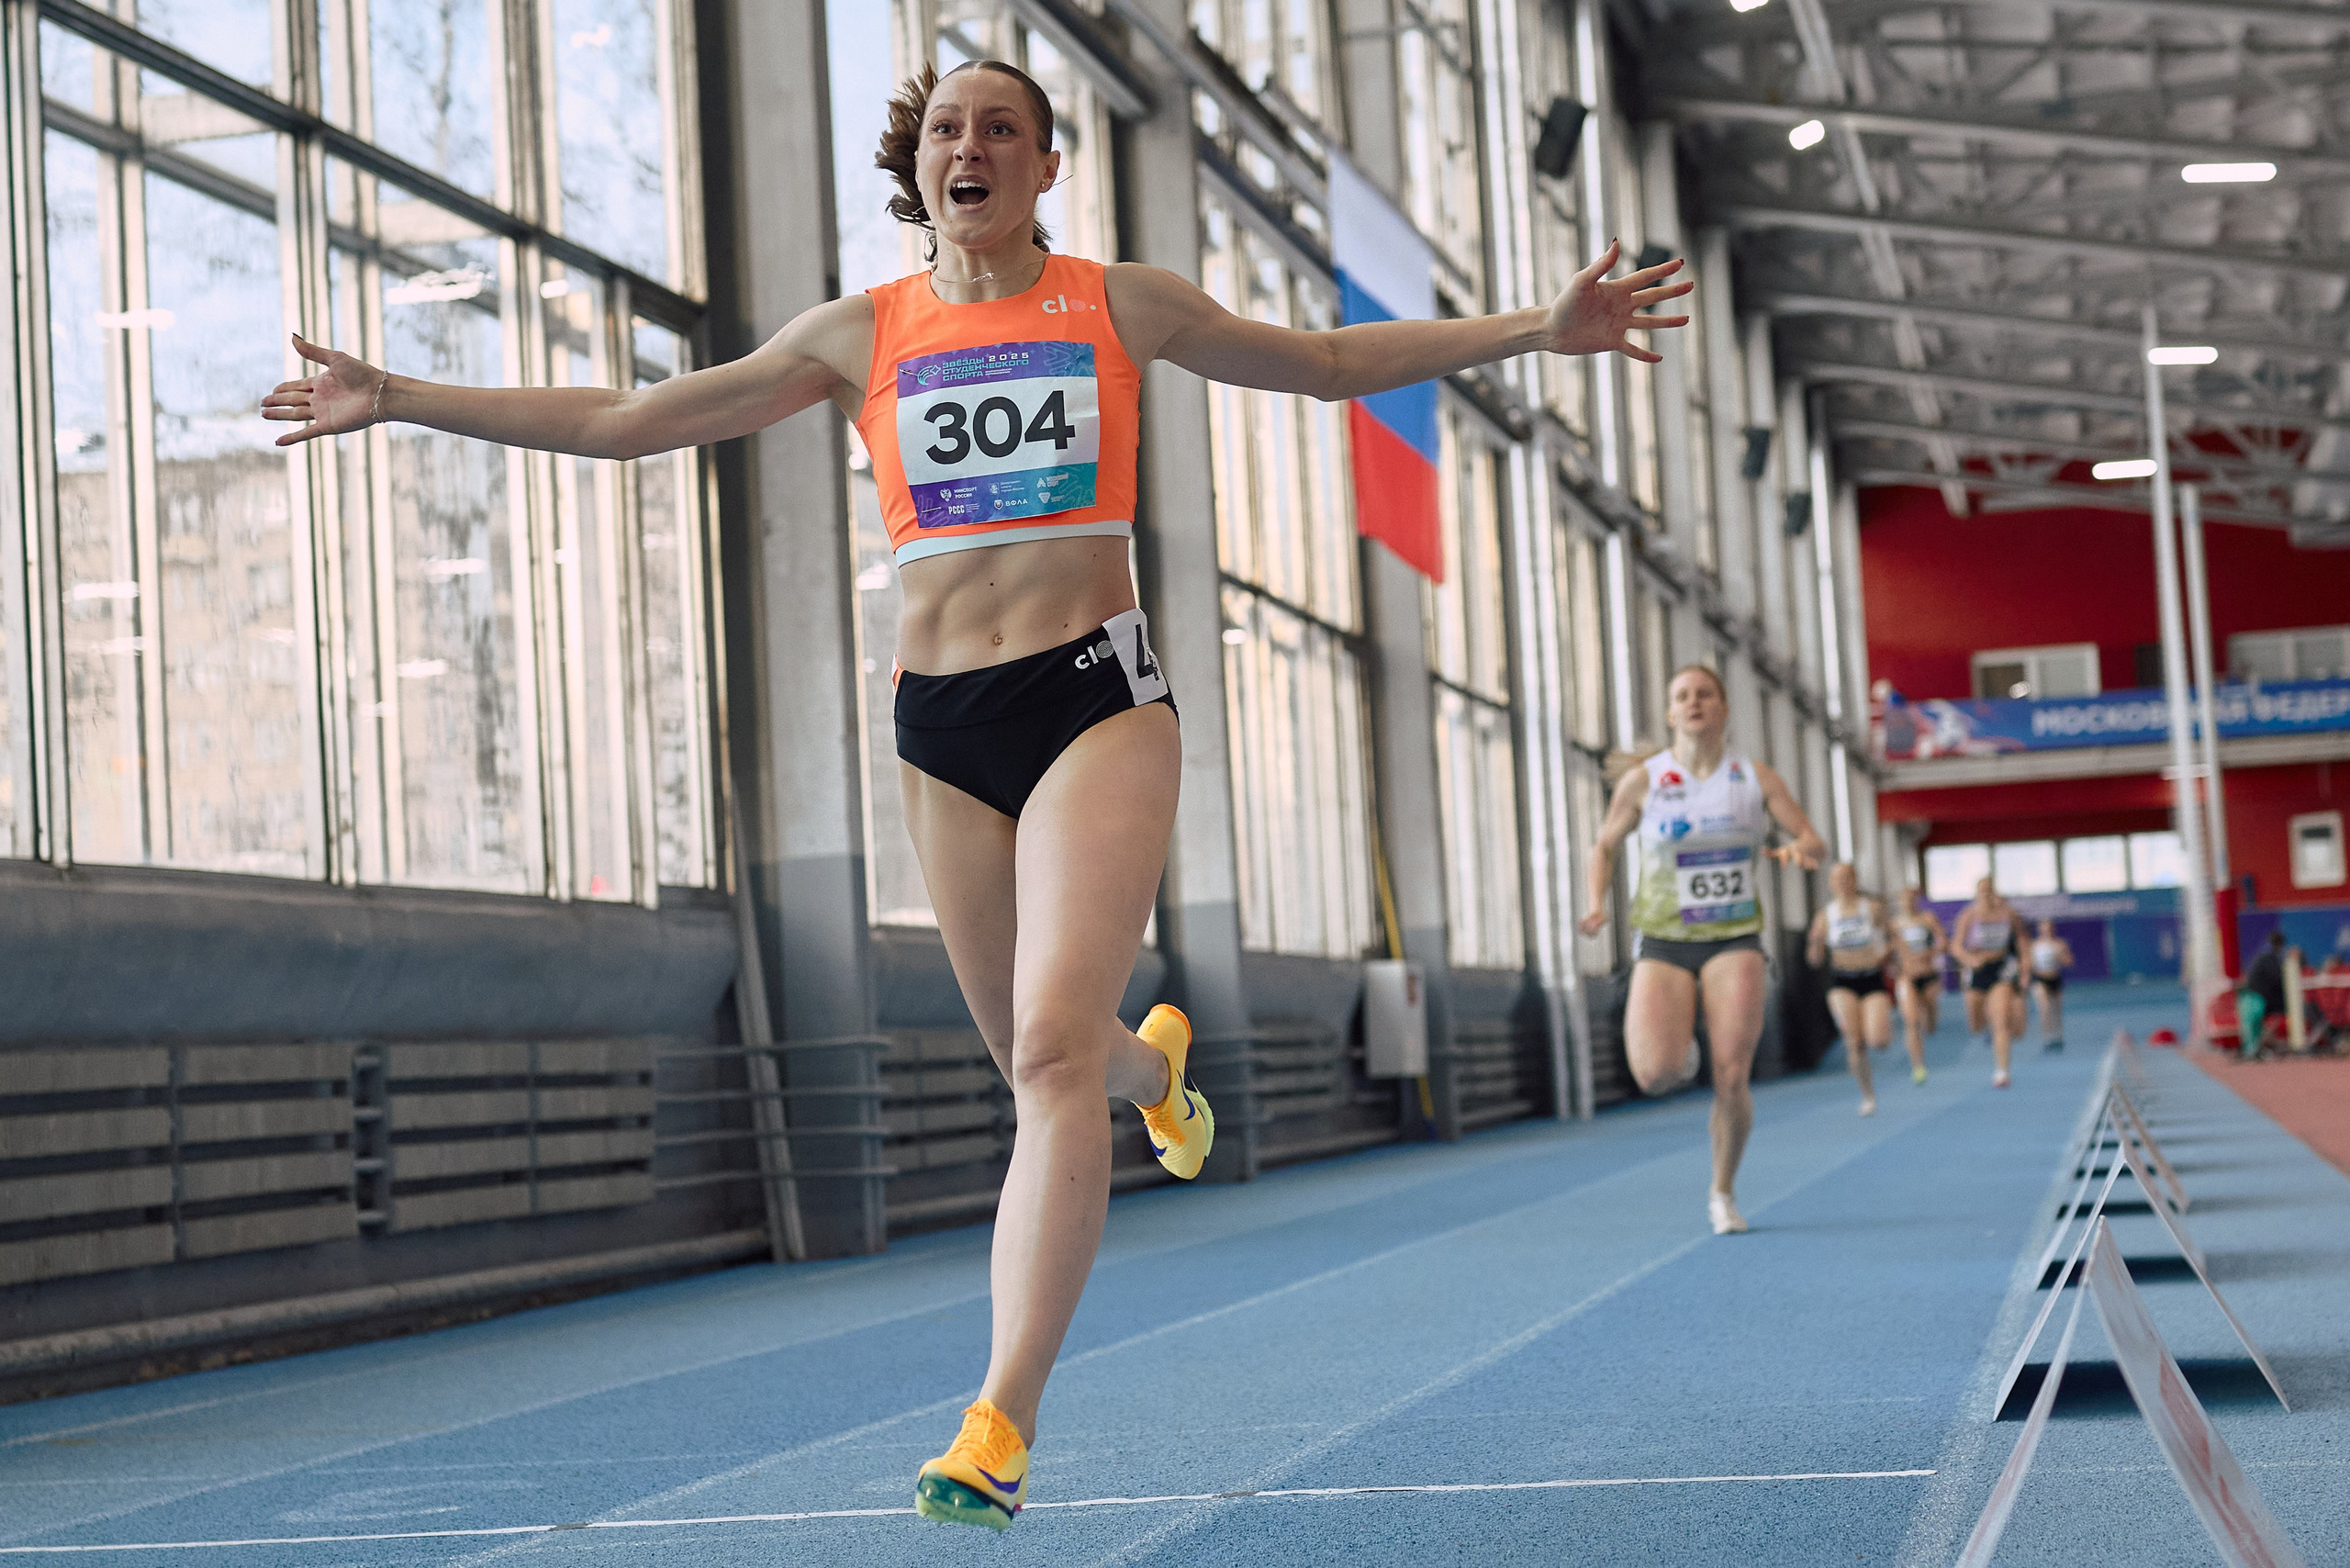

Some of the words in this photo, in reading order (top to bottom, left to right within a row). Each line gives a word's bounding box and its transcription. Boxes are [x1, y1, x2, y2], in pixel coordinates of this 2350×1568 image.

[989, 352, 1029, 363] 2025
[942, 359, 1029, 375] СТУДЕНЧЕСКОГО
[942, 370, 983, 382] СПОРТА
[923, 390, 1076, 465] 304
[1689, 870, 1743, 899] 632
